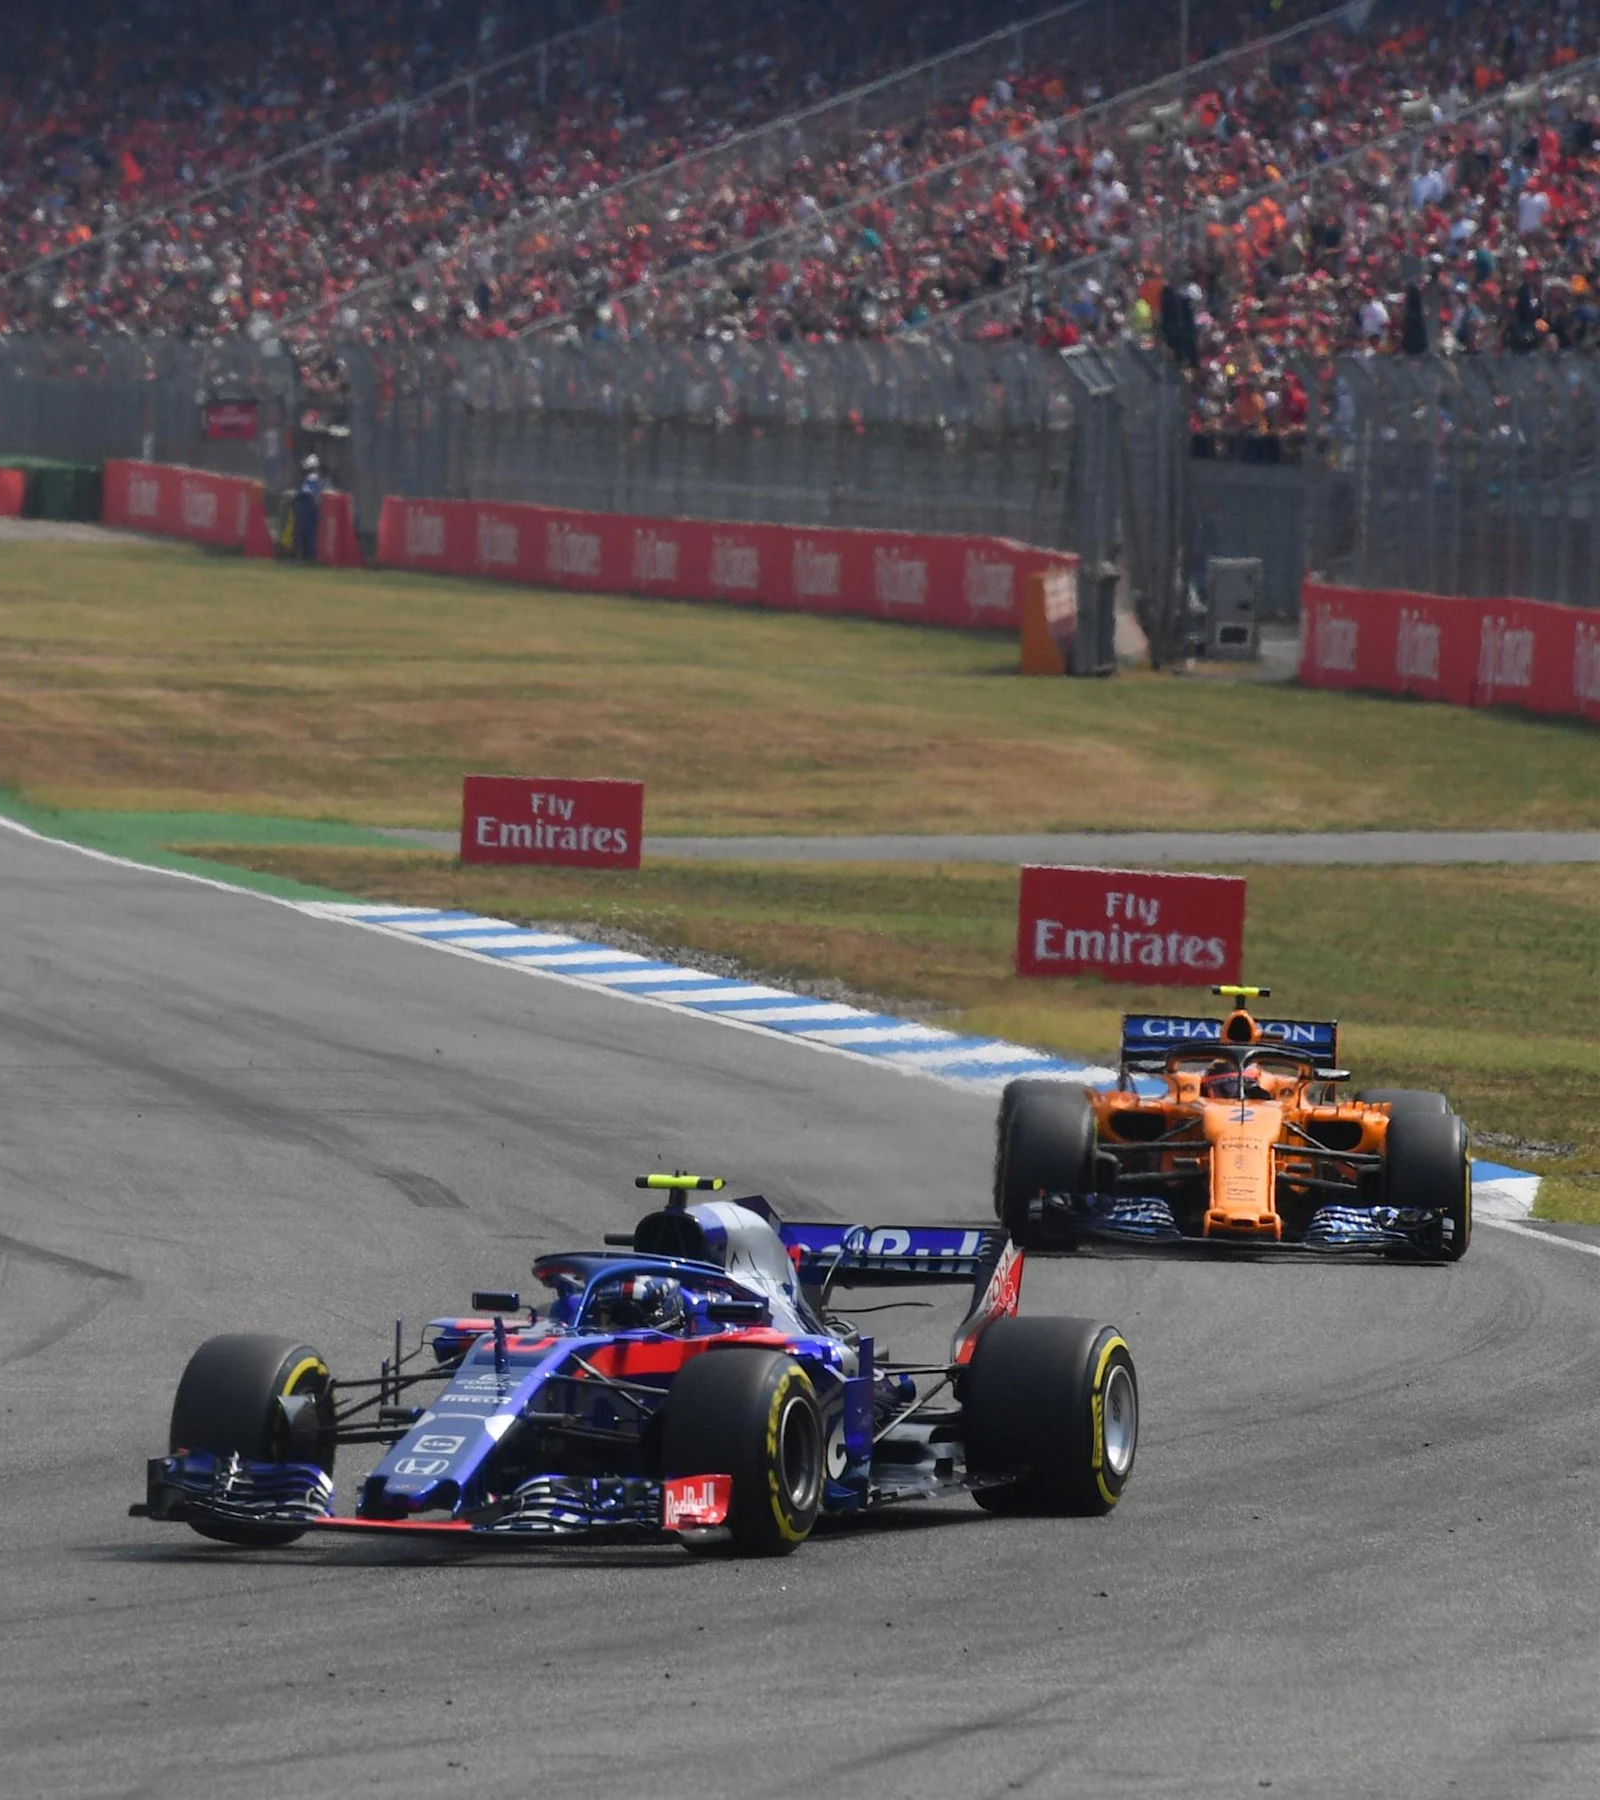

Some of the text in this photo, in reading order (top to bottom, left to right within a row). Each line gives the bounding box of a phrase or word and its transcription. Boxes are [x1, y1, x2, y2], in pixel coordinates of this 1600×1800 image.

[530, 792, 575, 821] Fly
[476, 815, 629, 854] Emirates
[1105, 891, 1161, 927] Fly
[1034, 918, 1227, 970] Emirates
[1142, 1019, 1316, 1042] CHAON
